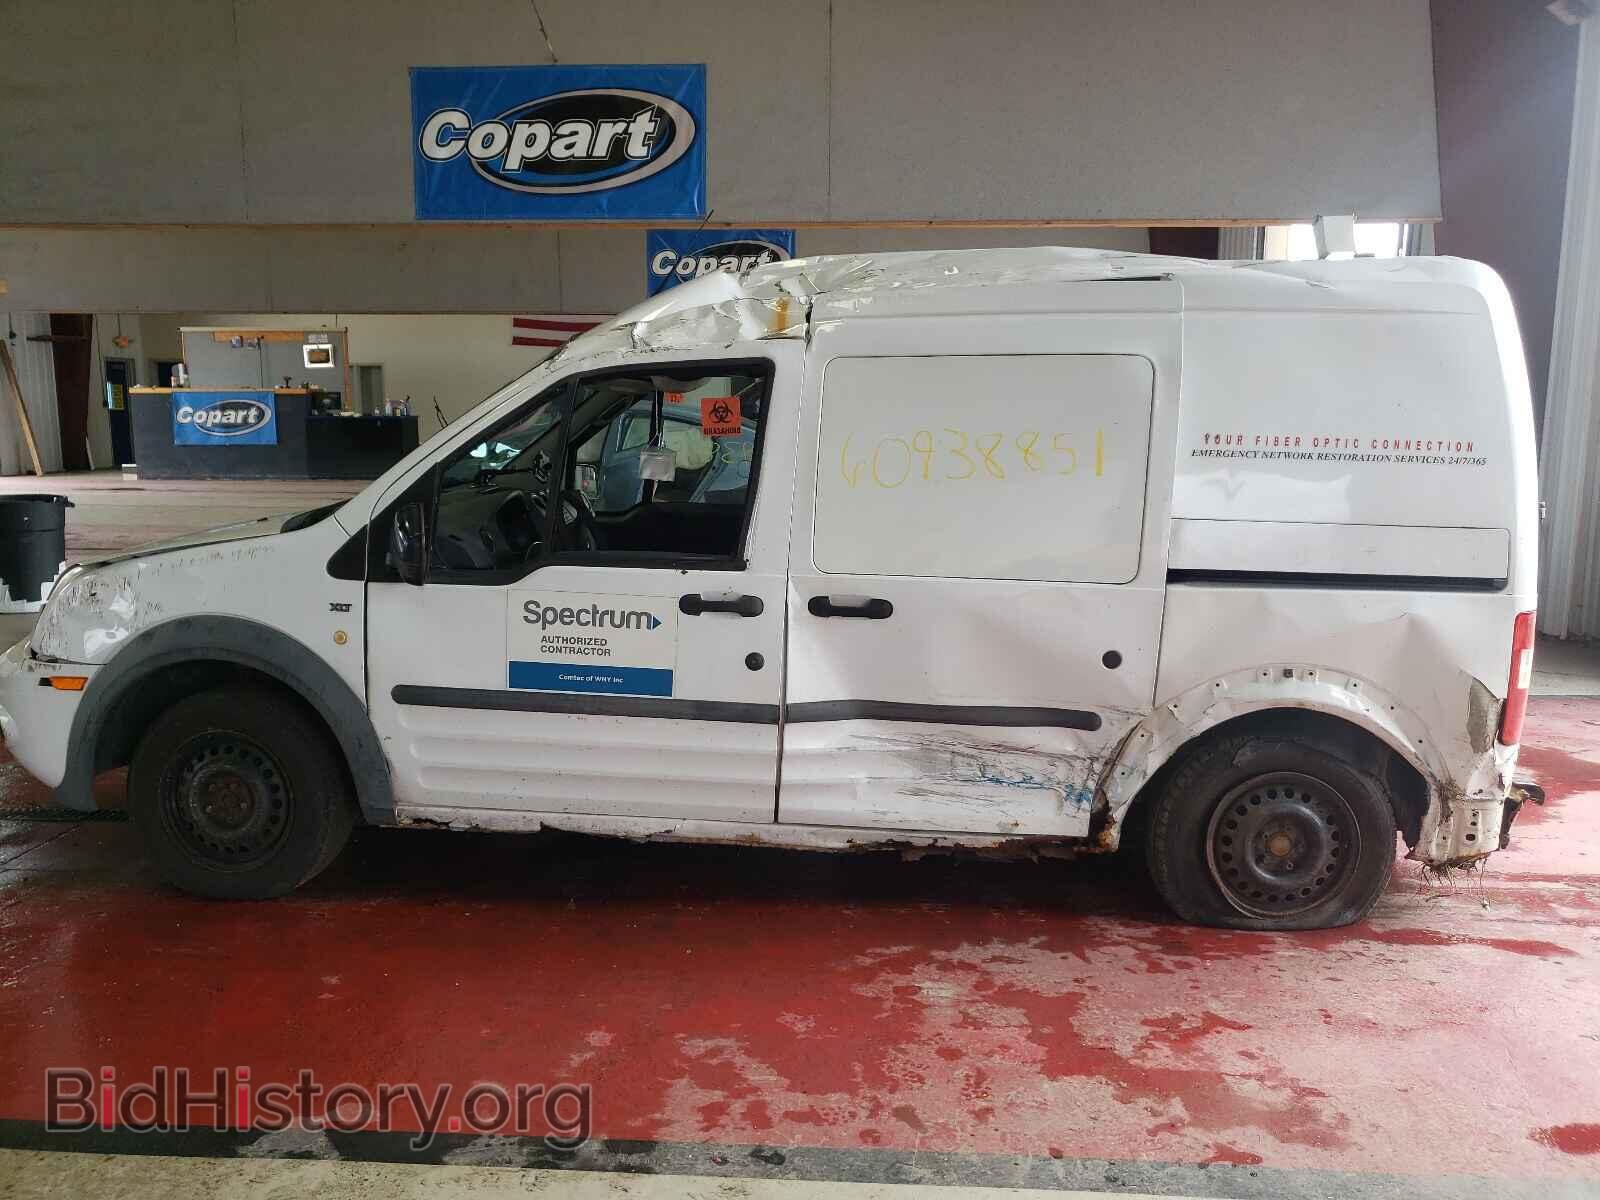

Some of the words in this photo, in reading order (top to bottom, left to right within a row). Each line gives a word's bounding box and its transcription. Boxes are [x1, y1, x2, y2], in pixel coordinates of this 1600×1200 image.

[419, 103, 660, 173] Copart
[175, 405, 258, 427] Copart
[1203, 432, 1243, 446] YOUR
[1255, 435, 1302, 447] FIBER
[1312, 437, 1360, 448] OPTIC
[1371, 439, 1474, 453] CONNECTION
[840, 425, 1104, 489] 60938851
[1191, 448, 1259, 460] EMERGENCY
[1261, 451, 1315, 461] NETWORK
[1317, 452, 1392, 464] RESTORATION
[1394, 454, 1446, 465] SERVICES
[1447, 456, 1488, 466] 24/7/365
[522, 599, 653, 630] Spectrum
[540, 635, 608, 647] AUTHORIZED
[540, 645, 612, 657] CONTRACTOR
[586, 674, 594, 683] of
[595, 675, 612, 683] WNY
[613, 676, 624, 684] Inc
